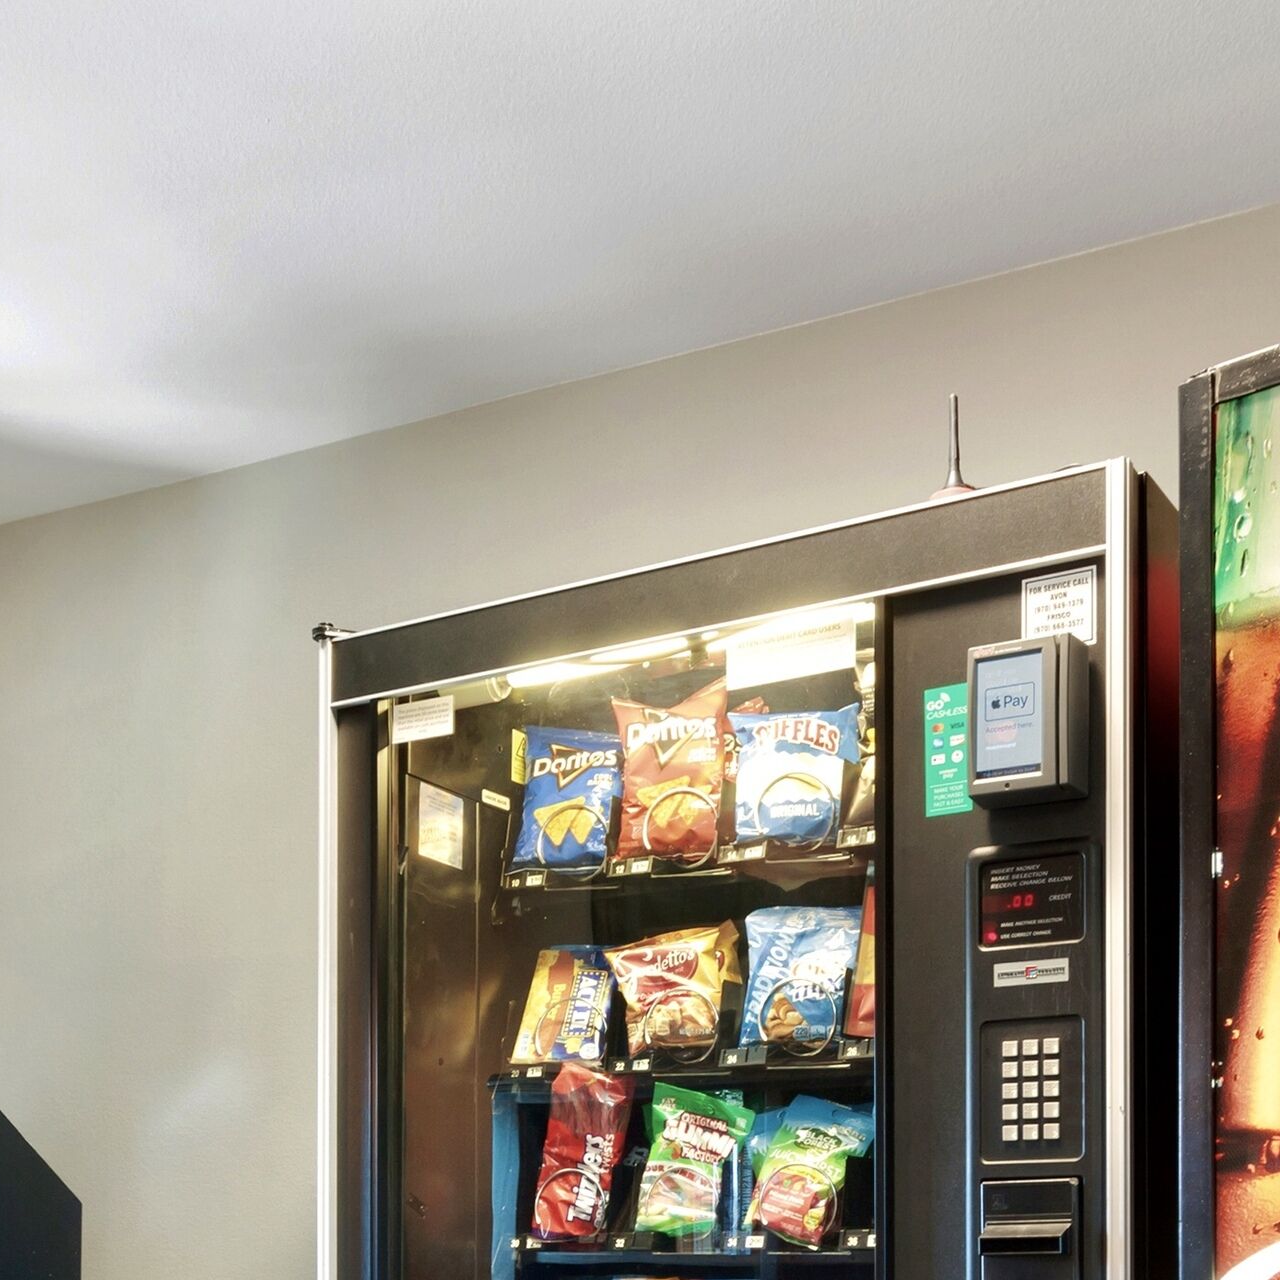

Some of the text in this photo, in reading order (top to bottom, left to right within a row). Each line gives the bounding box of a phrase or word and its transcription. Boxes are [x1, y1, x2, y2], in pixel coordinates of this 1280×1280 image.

[1029, 577, 1089, 595] FOR SERVICE CALL
[1050, 592, 1068, 601] AVON
[926, 700, 944, 711] GO
[1003, 694, 1029, 709] Pay
[926, 705, 968, 720] CASHLESS
[533, 749, 618, 778] Doritos
[990, 864, 1041, 875] INSERT MONEY
[990, 871, 1049, 882] MAKE SELECTION
[990, 875, 1073, 890] RECEIVE CHANGE BELOW
[1048, 893, 1072, 902] CREDIT
[615, 1062, 625, 1071] 22
